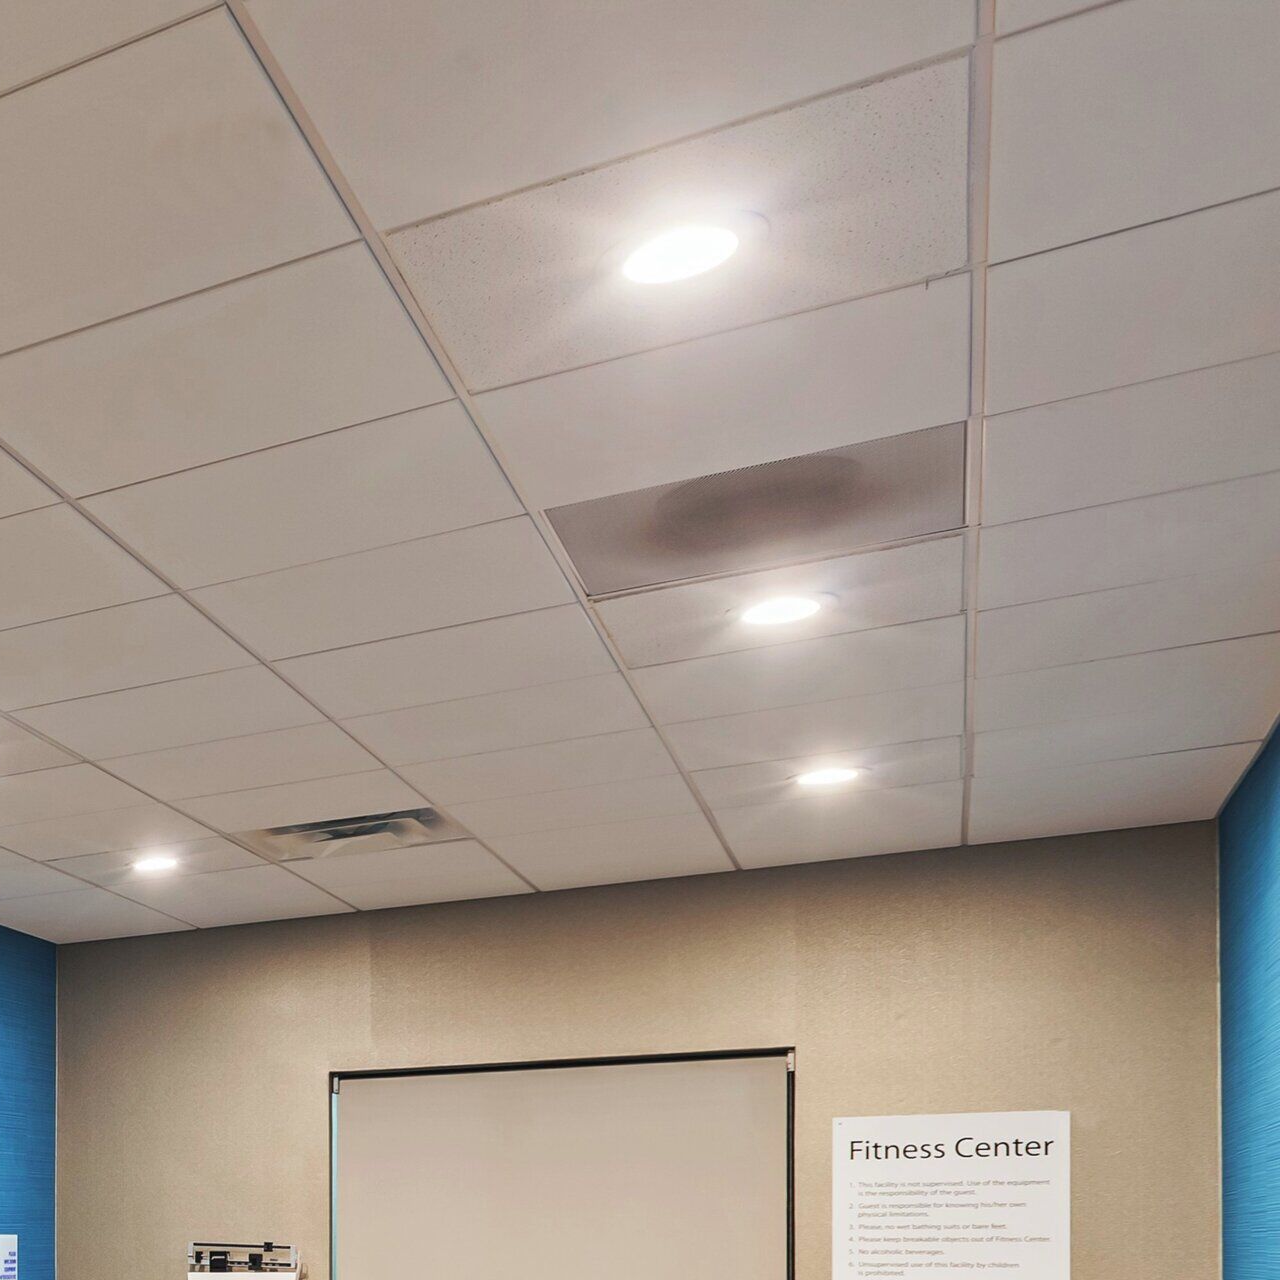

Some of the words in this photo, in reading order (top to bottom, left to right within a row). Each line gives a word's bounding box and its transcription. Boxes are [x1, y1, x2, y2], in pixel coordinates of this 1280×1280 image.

[849, 1140, 946, 1160] Fitness
[955, 1137, 1055, 1158] Center
[906, 1180, 920, 1188] not
